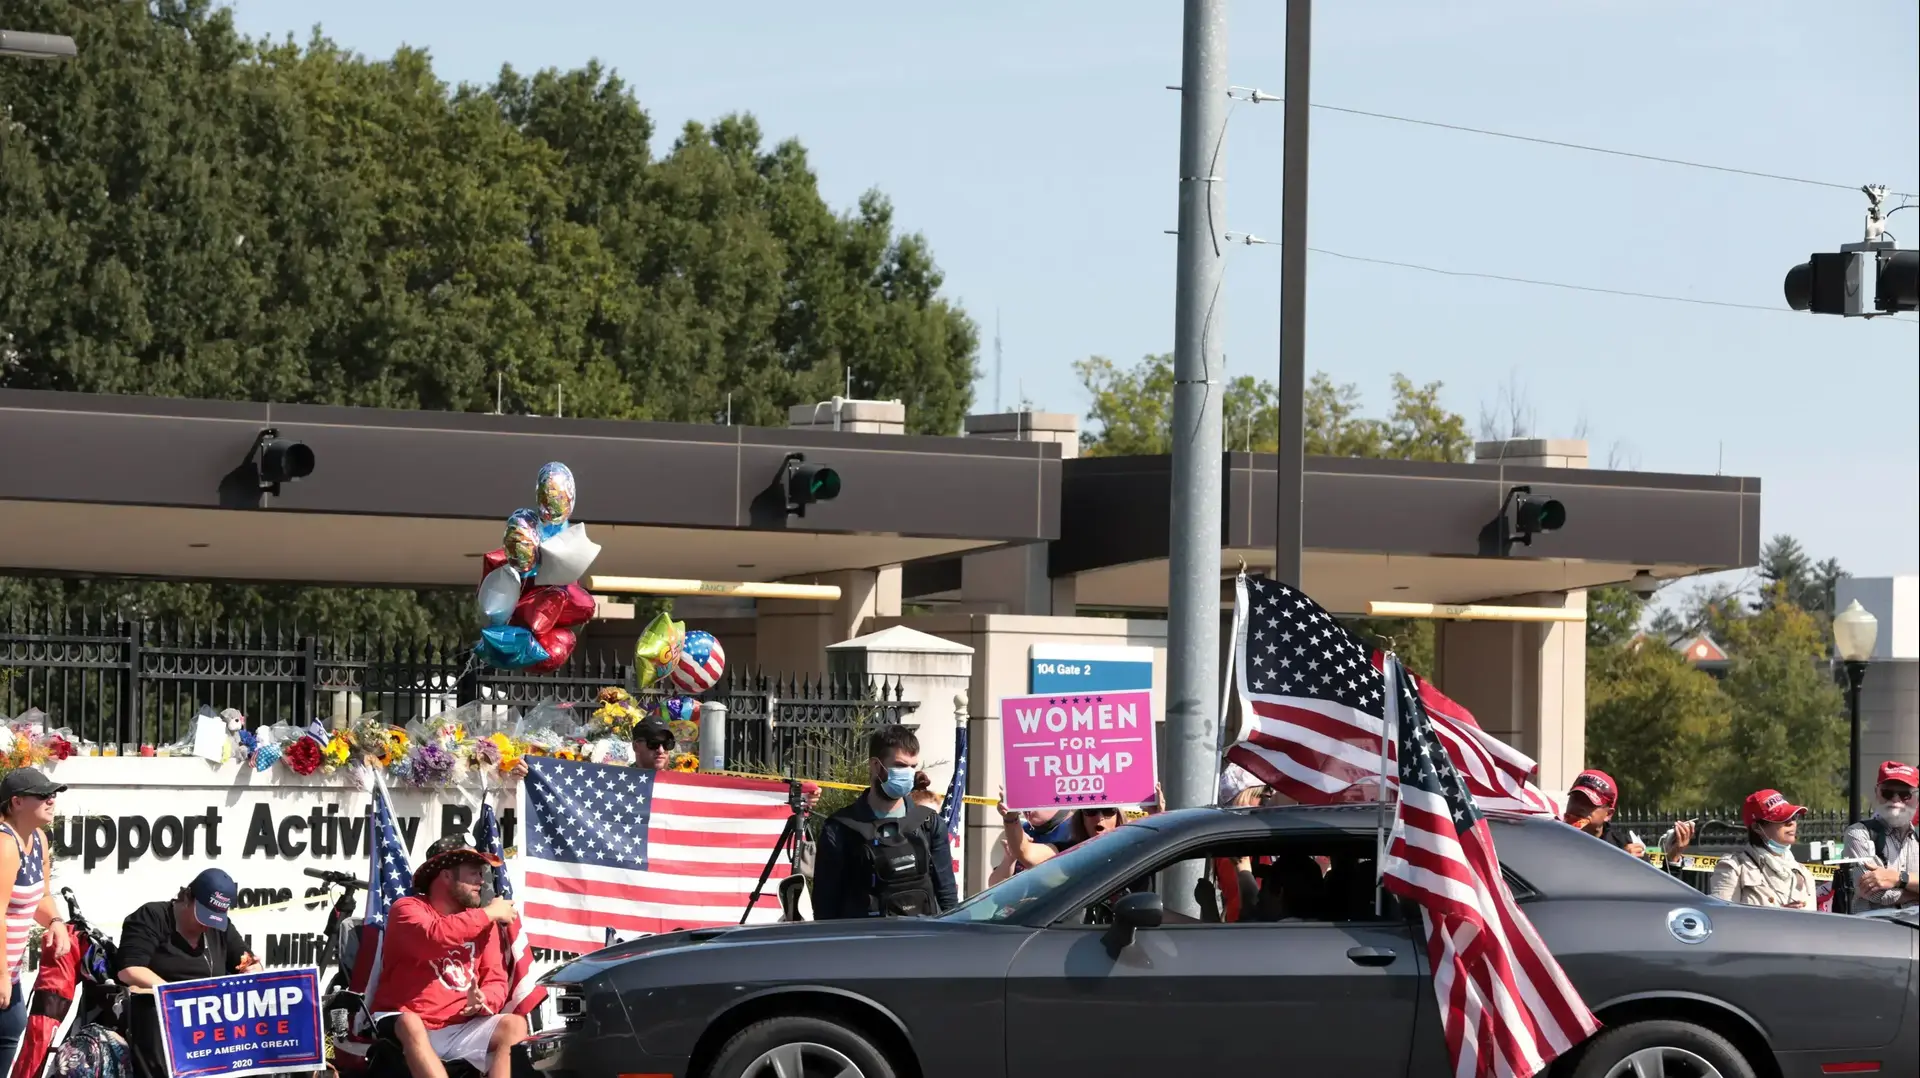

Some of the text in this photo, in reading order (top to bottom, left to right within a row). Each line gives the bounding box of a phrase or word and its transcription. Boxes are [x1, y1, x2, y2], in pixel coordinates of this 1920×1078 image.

[1036, 663, 1092, 675] 104 Gate 2
[1015, 703, 1137, 734] WOMEN
[1059, 737, 1096, 750] FOR
[1023, 751, 1133, 777] TRUMP
[1057, 777, 1103, 793] 2020
[51, 806, 222, 872] upport
[174, 986, 303, 1028] TRUMP
[193, 1020, 289, 1044] PENCE
[186, 1039, 299, 1060] KEEP AMERICA GREAT!
[232, 1058, 253, 1069] 2020
